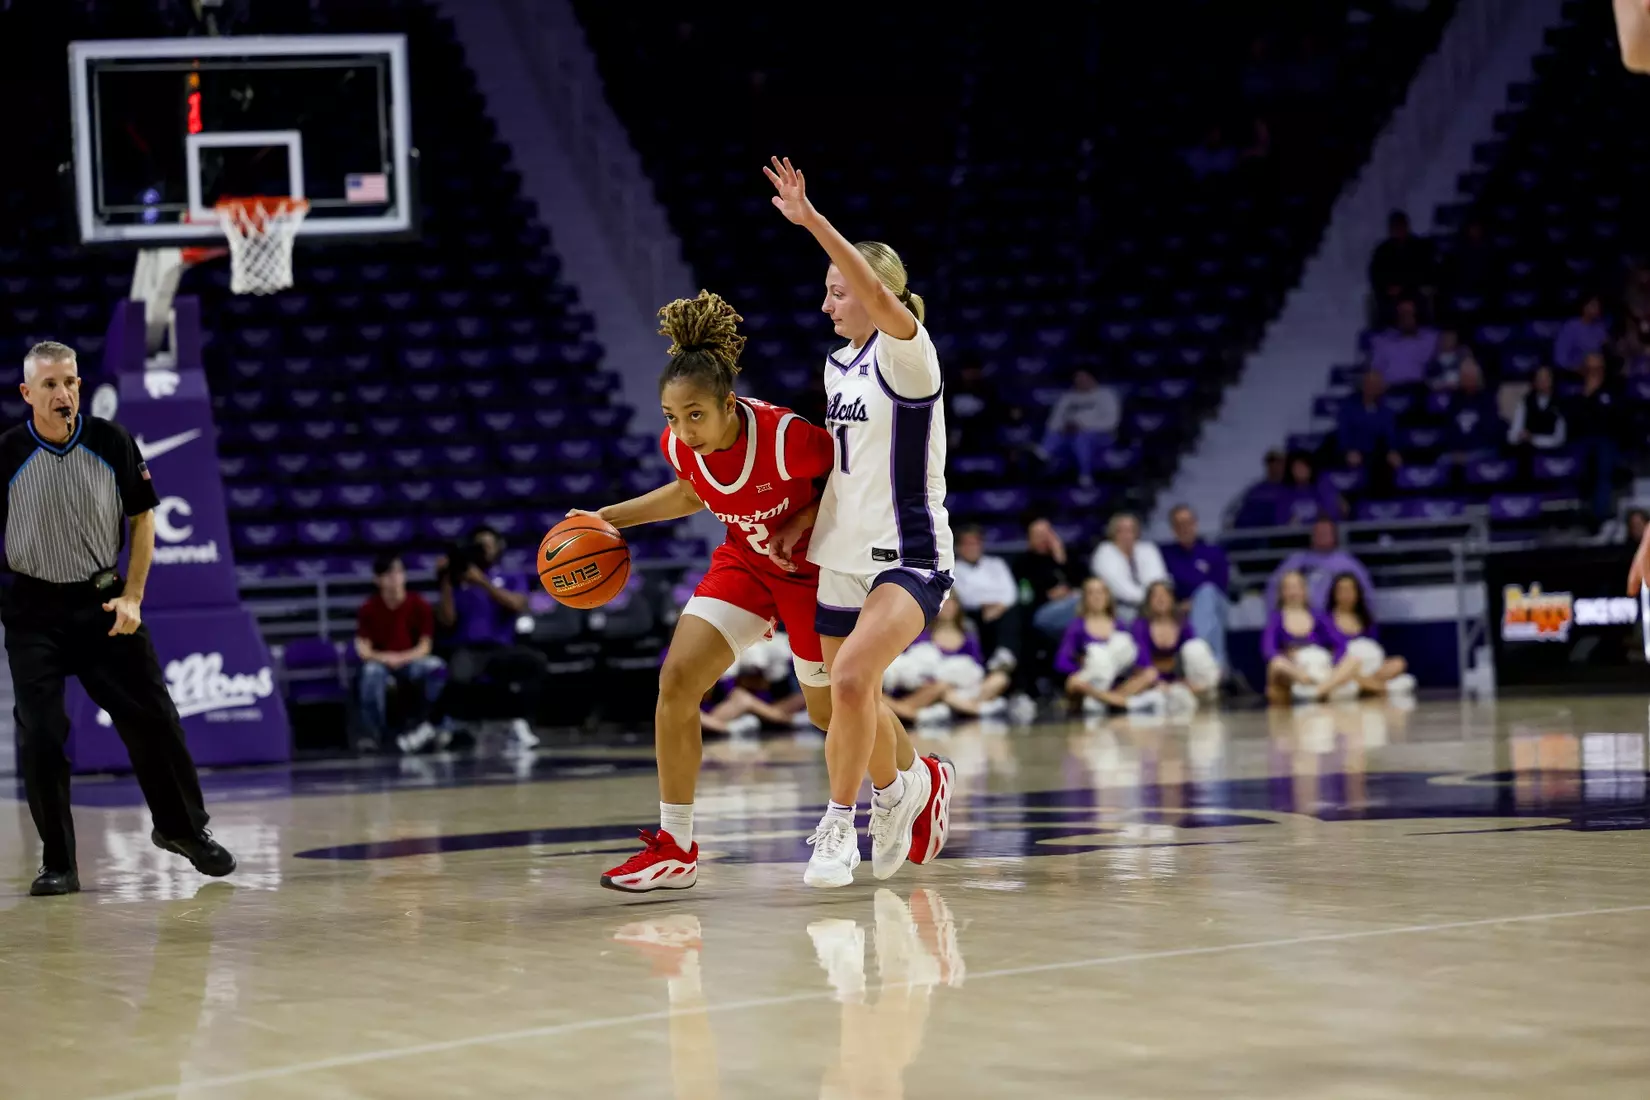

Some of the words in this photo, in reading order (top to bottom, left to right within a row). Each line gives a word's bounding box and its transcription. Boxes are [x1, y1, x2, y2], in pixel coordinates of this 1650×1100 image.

[827, 392, 869, 421] dcats
[738, 521, 770, 556] 2
[551, 561, 600, 588] ELITE
[165, 652, 273, 703] illons
